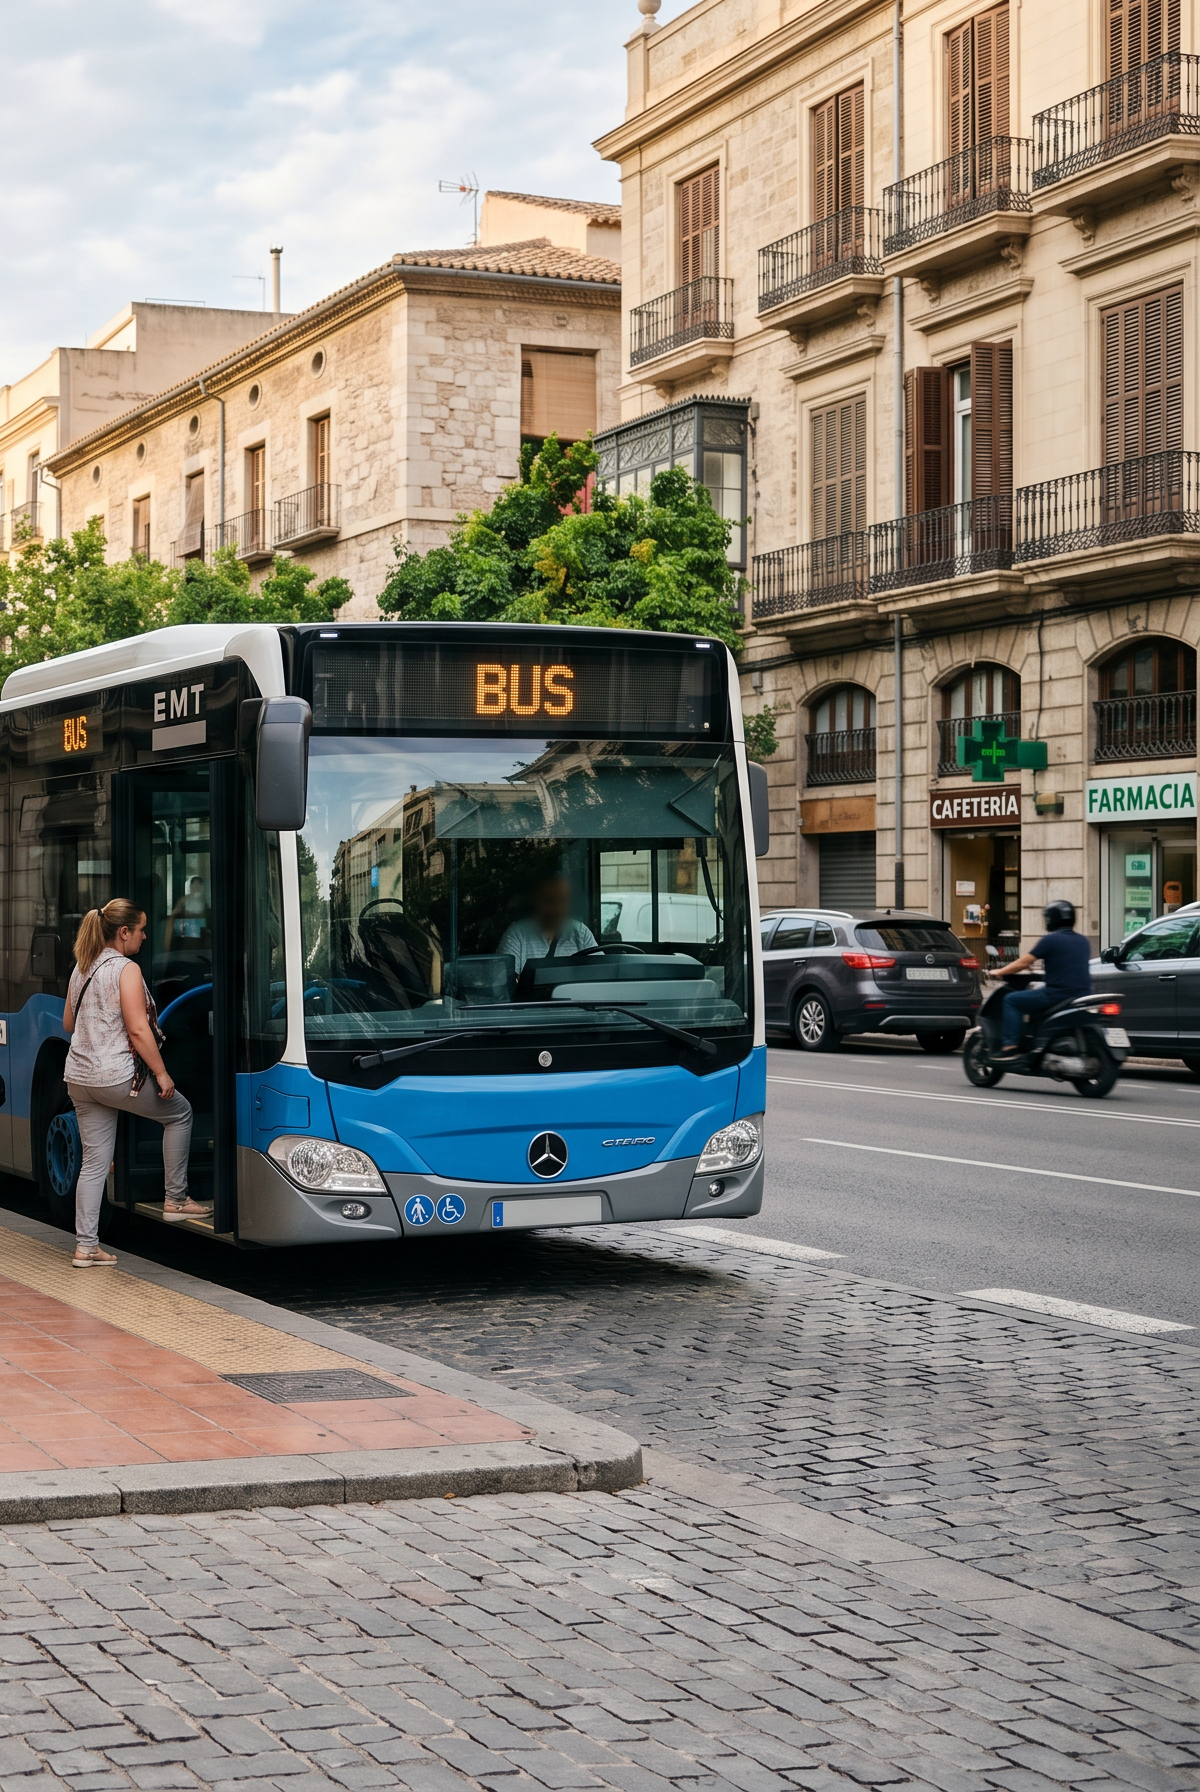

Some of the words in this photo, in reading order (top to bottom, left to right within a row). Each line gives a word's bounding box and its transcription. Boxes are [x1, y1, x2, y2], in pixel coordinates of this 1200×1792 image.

[153, 683, 205, 723] EMT
[477, 664, 575, 716] BUS
[63, 715, 89, 753] BUS
[932, 791, 1019, 820] CAFETERÍA
[1089, 783, 1195, 814] FARMACIA
